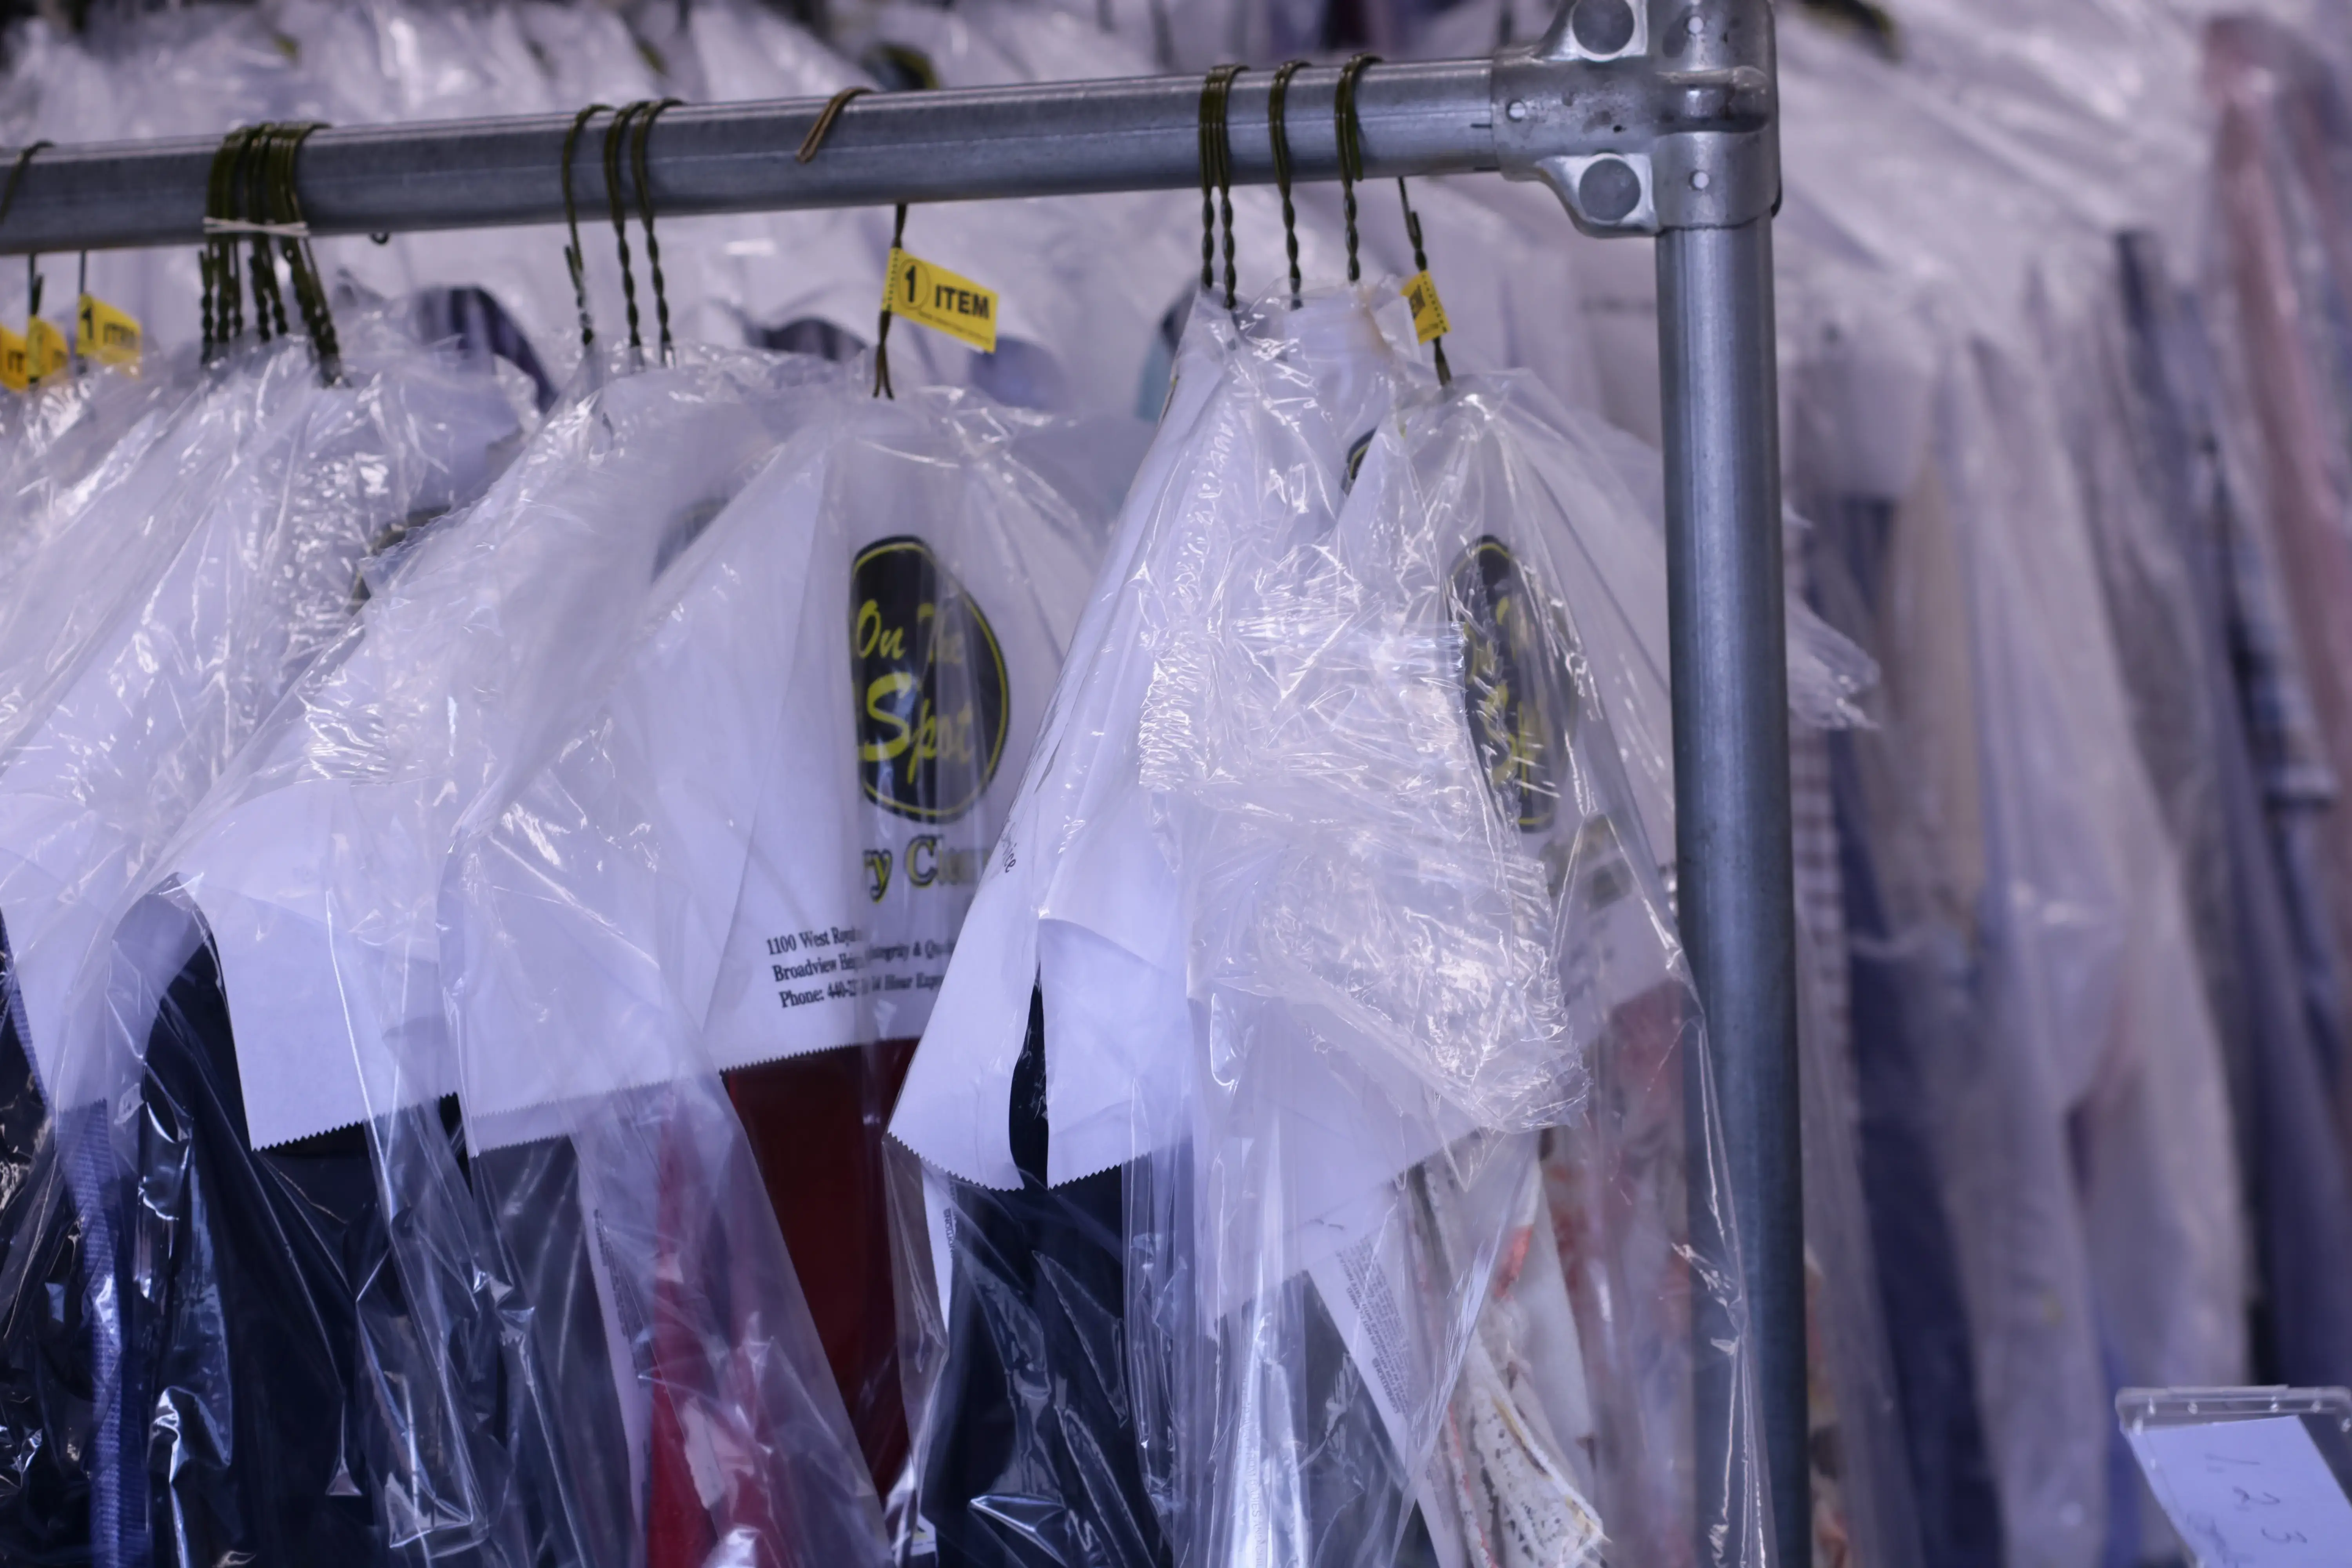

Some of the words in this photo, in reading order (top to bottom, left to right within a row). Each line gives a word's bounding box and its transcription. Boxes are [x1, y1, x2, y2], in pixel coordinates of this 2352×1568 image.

[904, 265, 916, 303] 1
[935, 283, 991, 320] ITEM
[856, 599, 906, 660] On
[767, 934, 797, 955] 1100
[798, 930, 831, 949] West
[772, 956, 837, 982] Broadview
[778, 989, 825, 1008] Phone:
